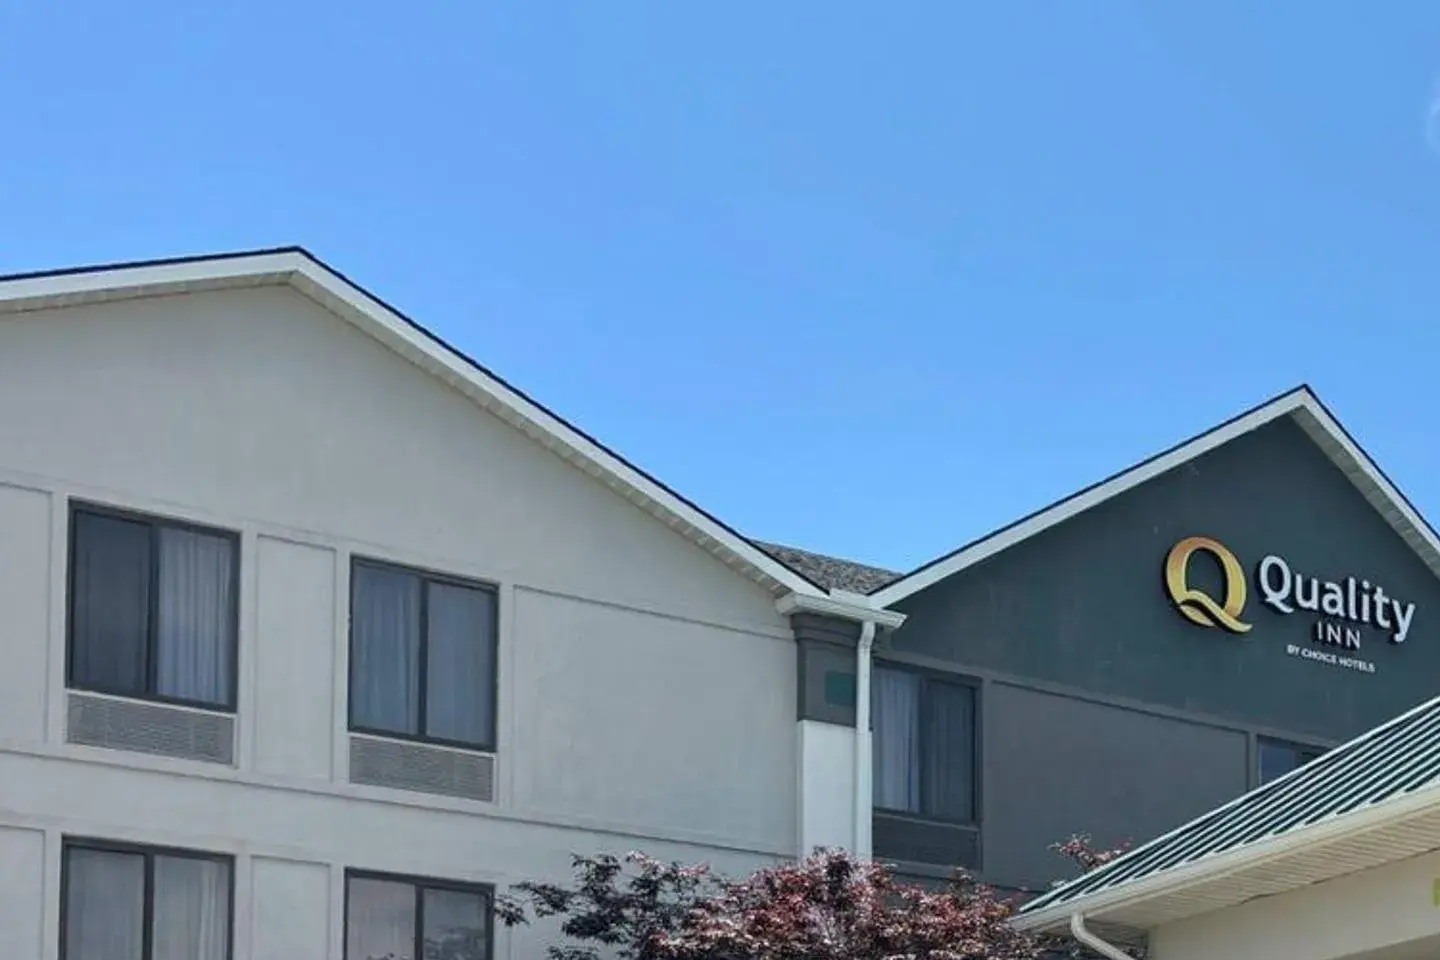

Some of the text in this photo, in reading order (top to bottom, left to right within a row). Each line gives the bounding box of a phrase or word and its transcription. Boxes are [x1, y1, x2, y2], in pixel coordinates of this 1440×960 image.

[1166, 536, 1253, 633] Q
[1259, 555, 1416, 642] Quality
[1287, 644, 1376, 673] BY CHOICE HOTELS
[1317, 620, 1361, 649] INN
